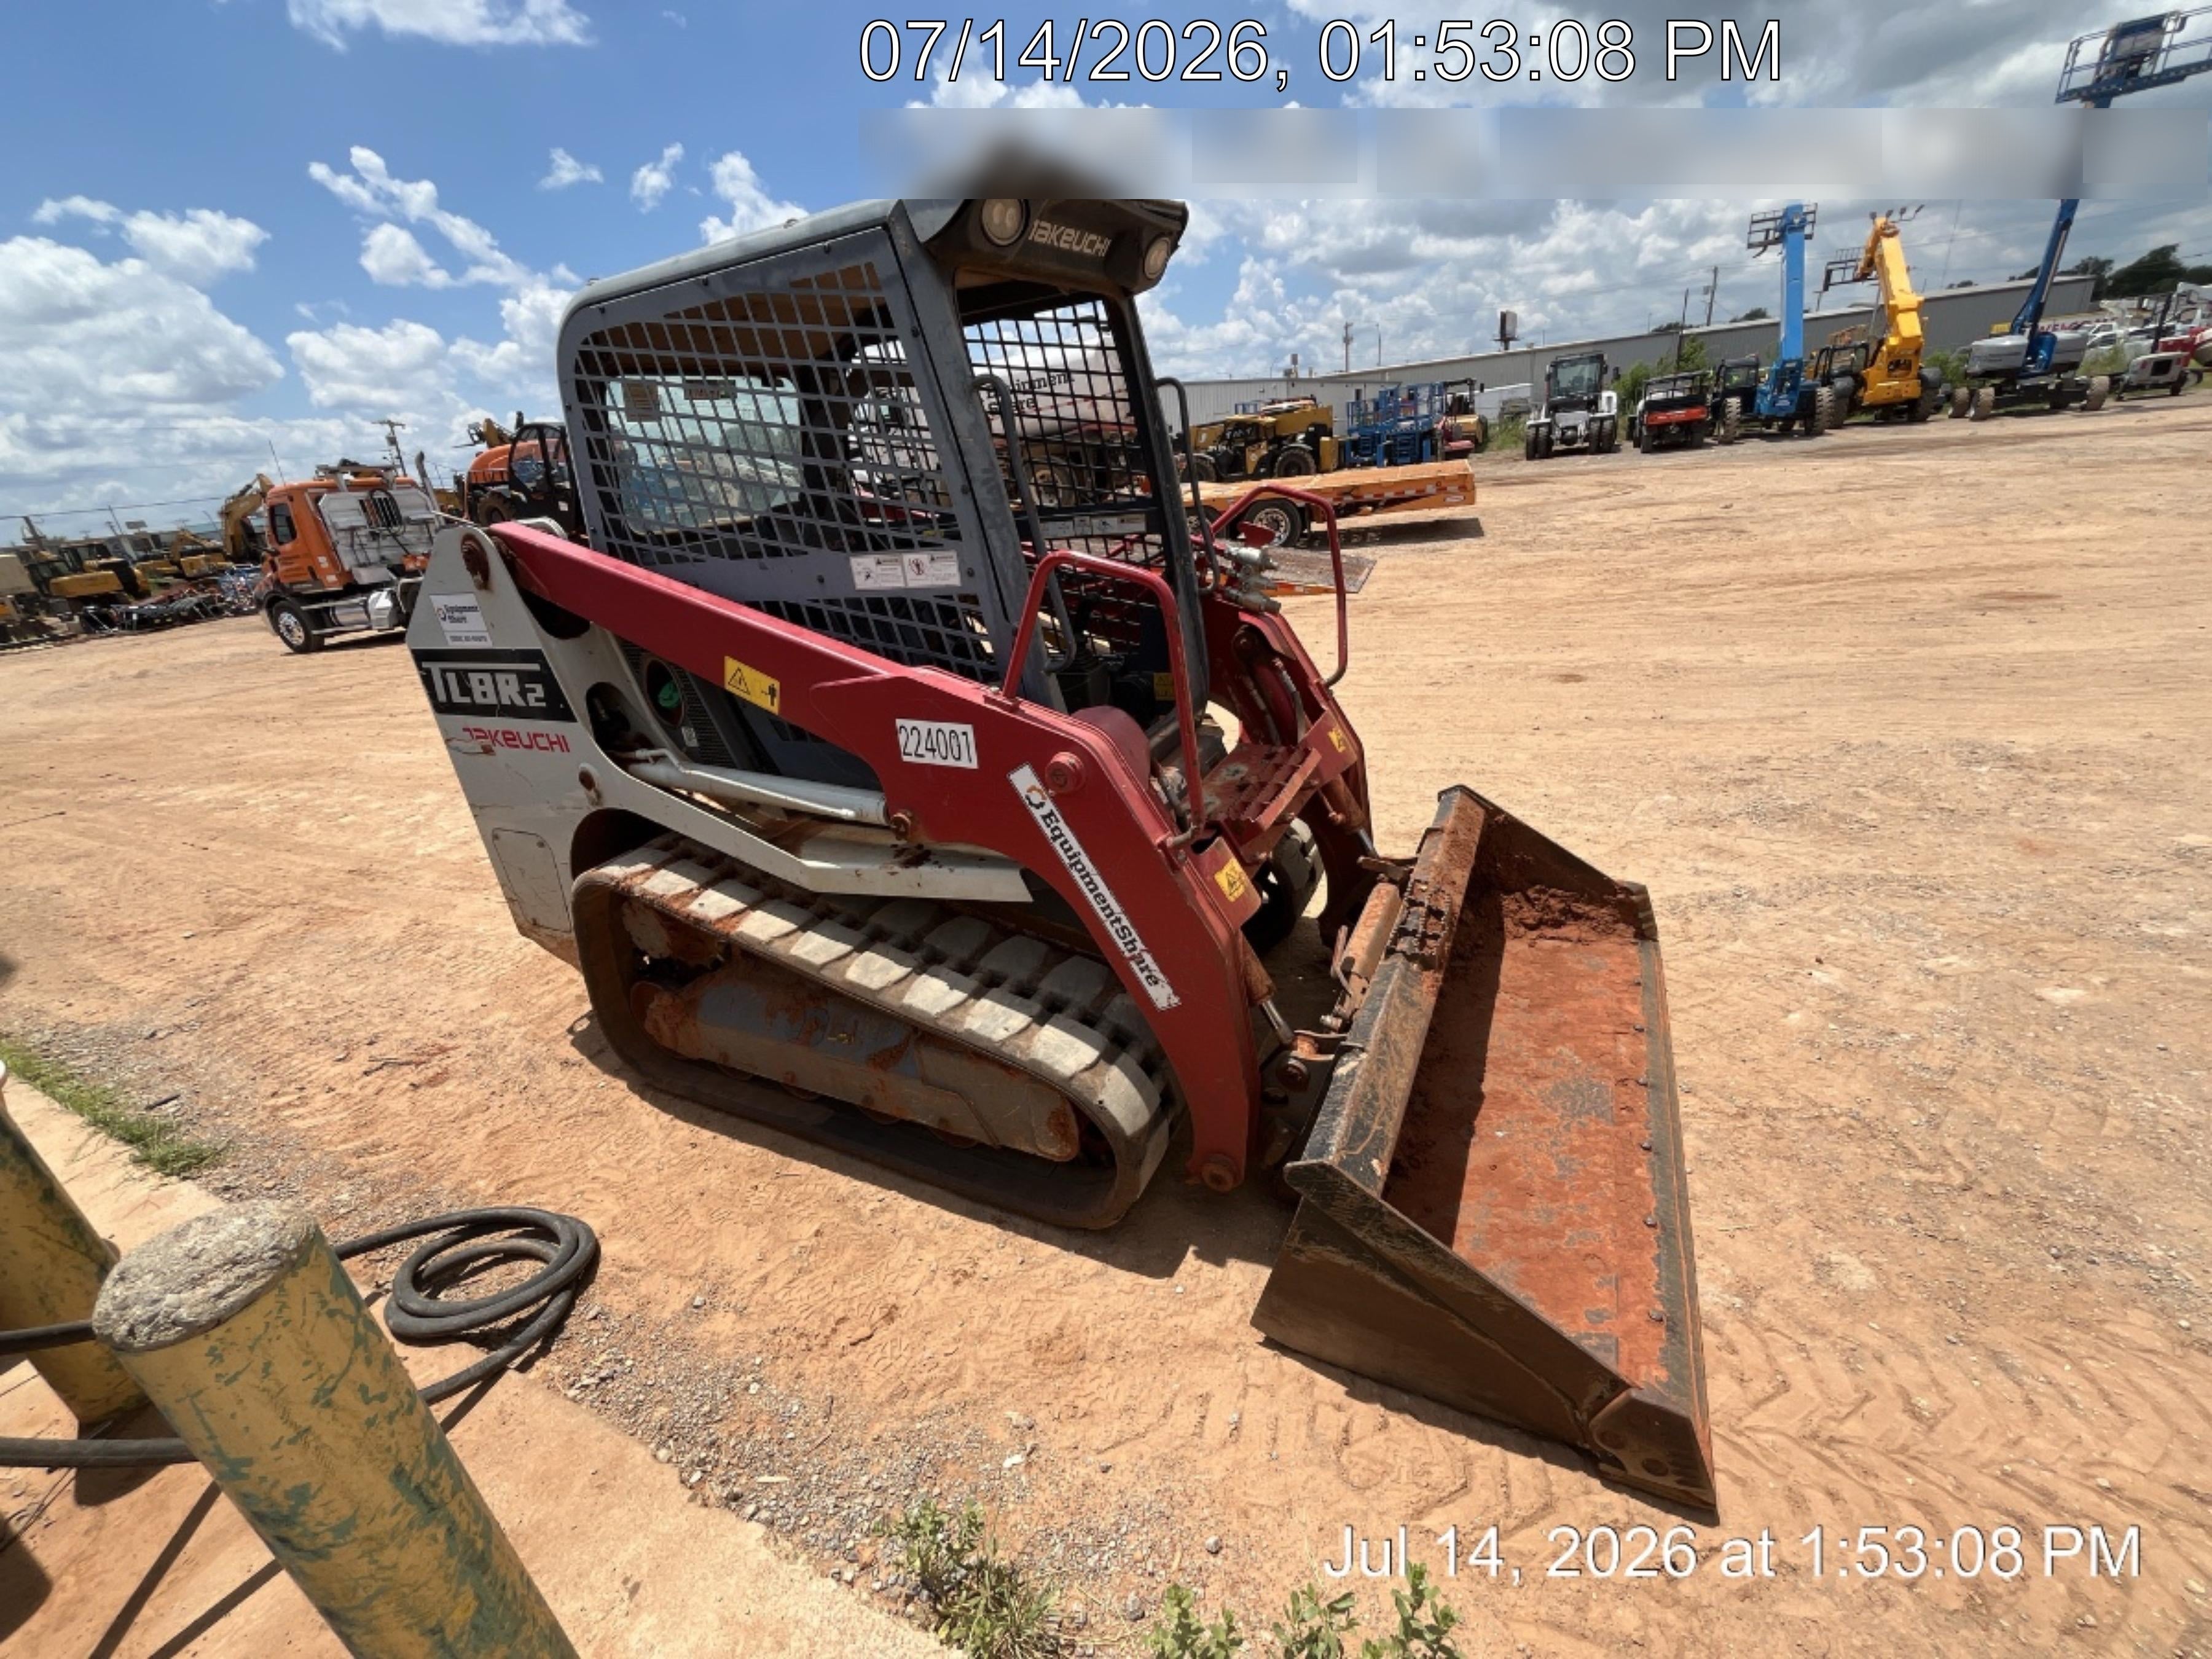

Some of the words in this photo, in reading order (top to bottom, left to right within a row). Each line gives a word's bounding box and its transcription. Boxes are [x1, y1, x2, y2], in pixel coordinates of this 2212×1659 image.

[1028, 219, 1112, 257] TAKEUCHI
[462, 727, 570, 753] TAKEUCHI
[899, 724, 972, 763] 224001
[1040, 809, 1159, 987] EquipmentShare
